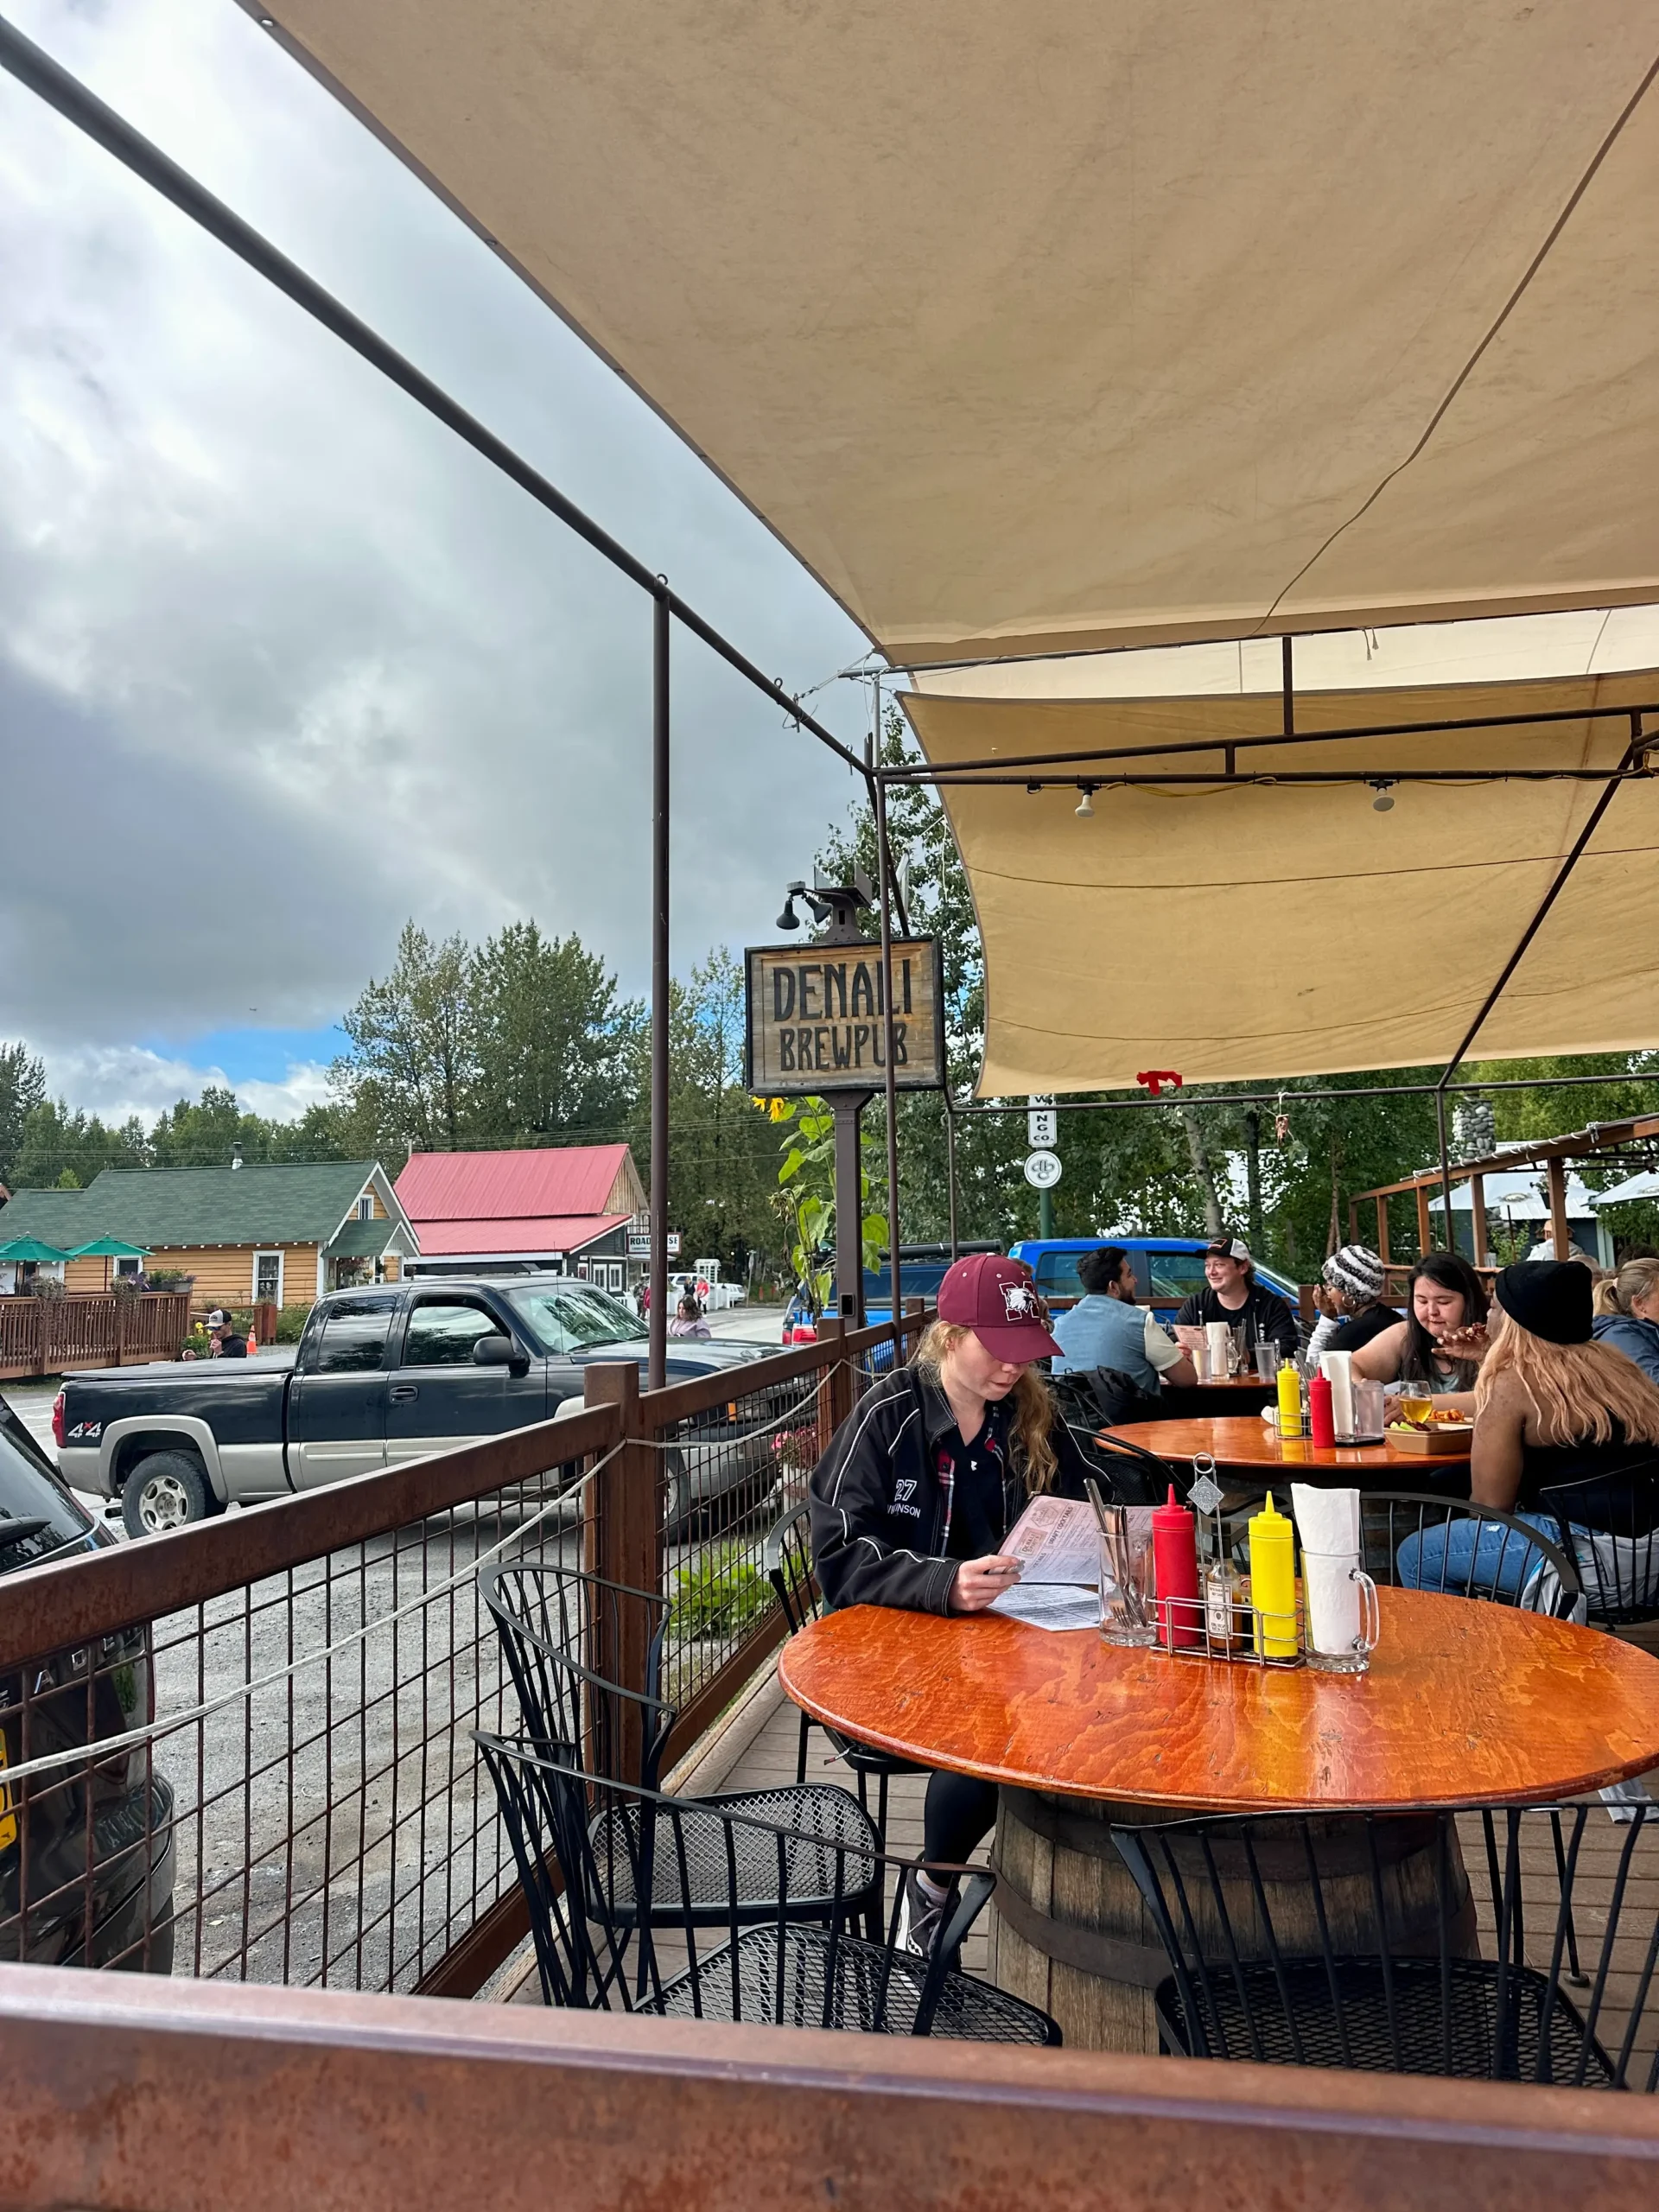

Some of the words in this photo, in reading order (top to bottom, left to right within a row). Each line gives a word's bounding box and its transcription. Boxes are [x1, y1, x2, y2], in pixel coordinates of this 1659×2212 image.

[772, 958, 912, 1022] DENALI
[779, 1022, 908, 1071] BREWPUB
[630, 1236, 677, 1245] ROADSE
[894, 1478, 918, 1502] 27
